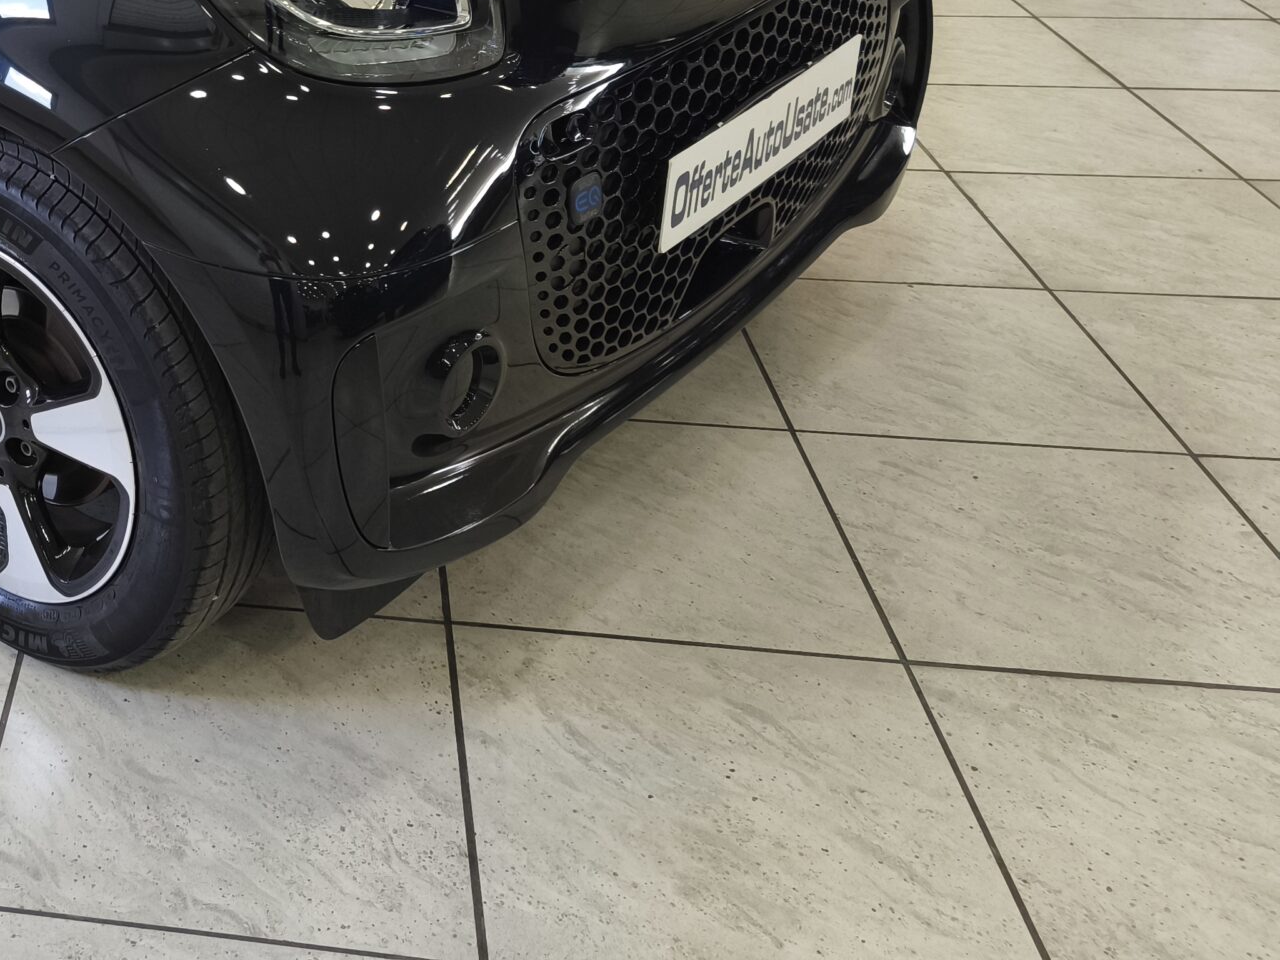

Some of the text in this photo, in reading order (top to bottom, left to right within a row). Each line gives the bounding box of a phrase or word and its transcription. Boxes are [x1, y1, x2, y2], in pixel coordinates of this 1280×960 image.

[671, 77, 854, 229] OfferteAutoUsate.com
[575, 185, 601, 213] EQ
[48, 261, 113, 342] PRIMACY
